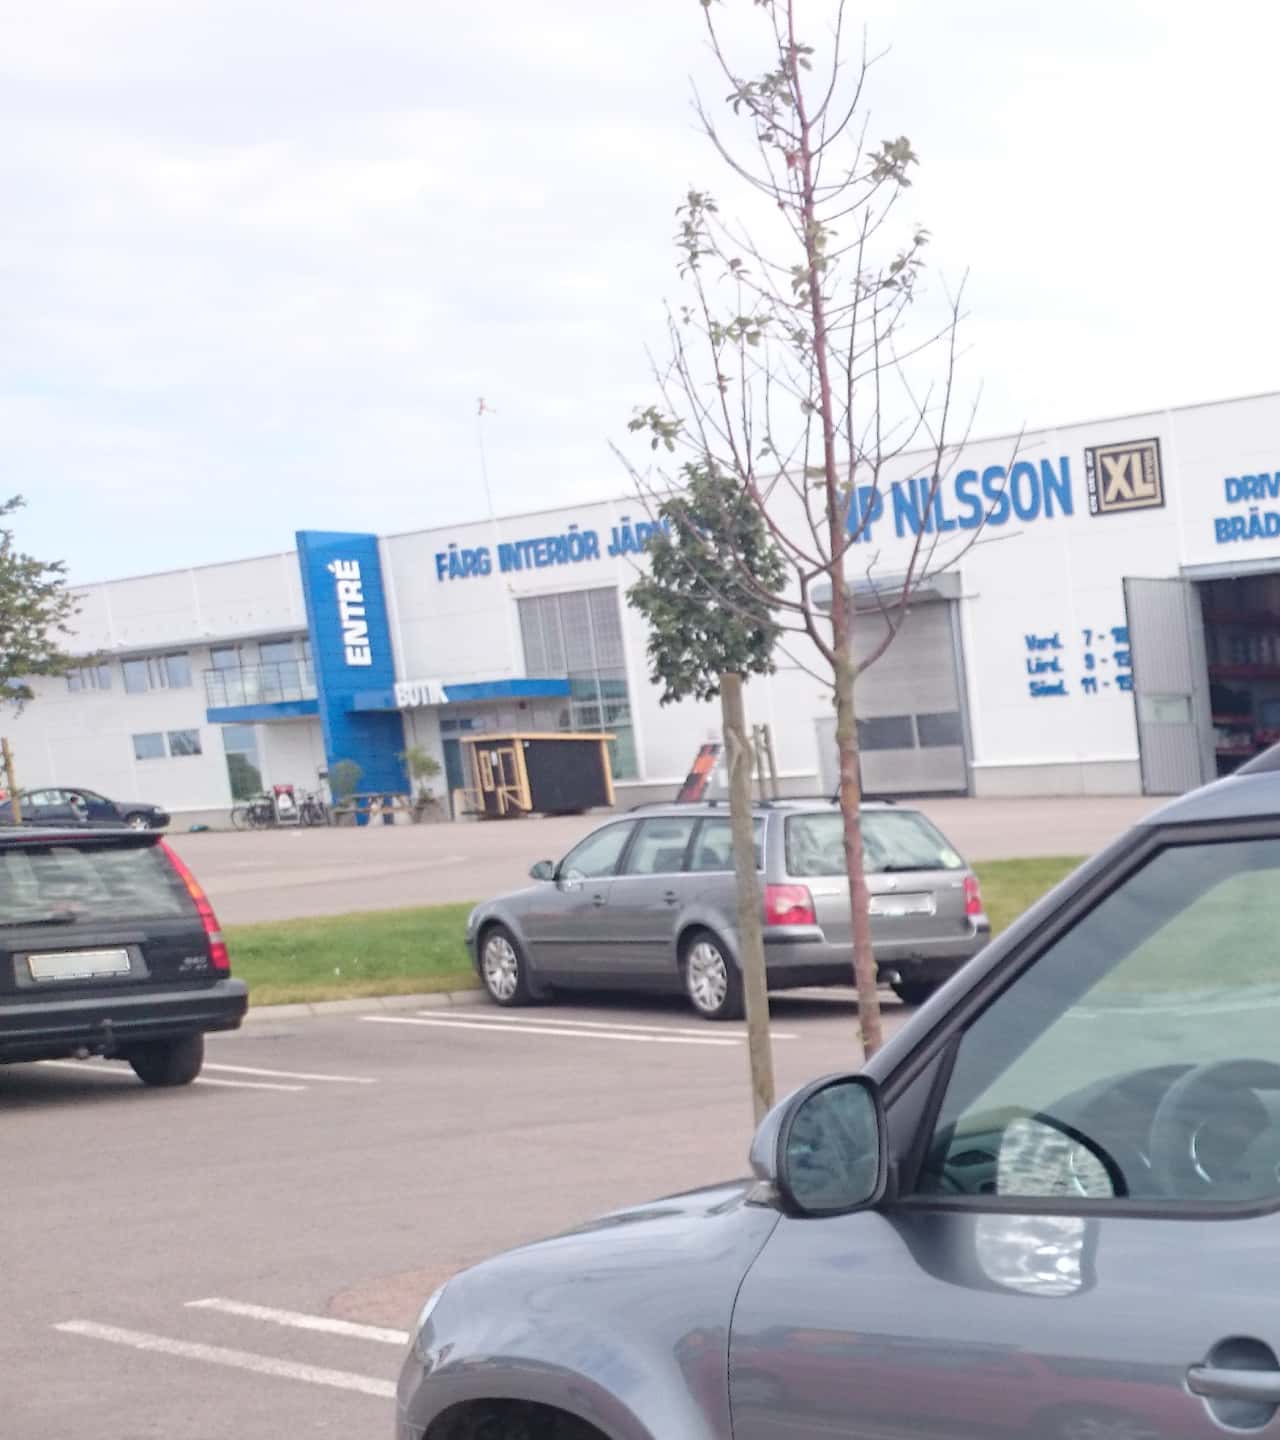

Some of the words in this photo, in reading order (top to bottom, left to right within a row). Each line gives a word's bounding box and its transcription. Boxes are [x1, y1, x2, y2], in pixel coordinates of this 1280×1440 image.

[891, 456, 1074, 538] NILSSON
[1101, 451, 1156, 502] XL
[434, 543, 492, 582] FÄRG
[497, 524, 601, 573] INTERIÖR
[328, 560, 373, 666] ENTRÉ
[1082, 629, 1092, 646] 7
[1081, 676, 1098, 694] 11
